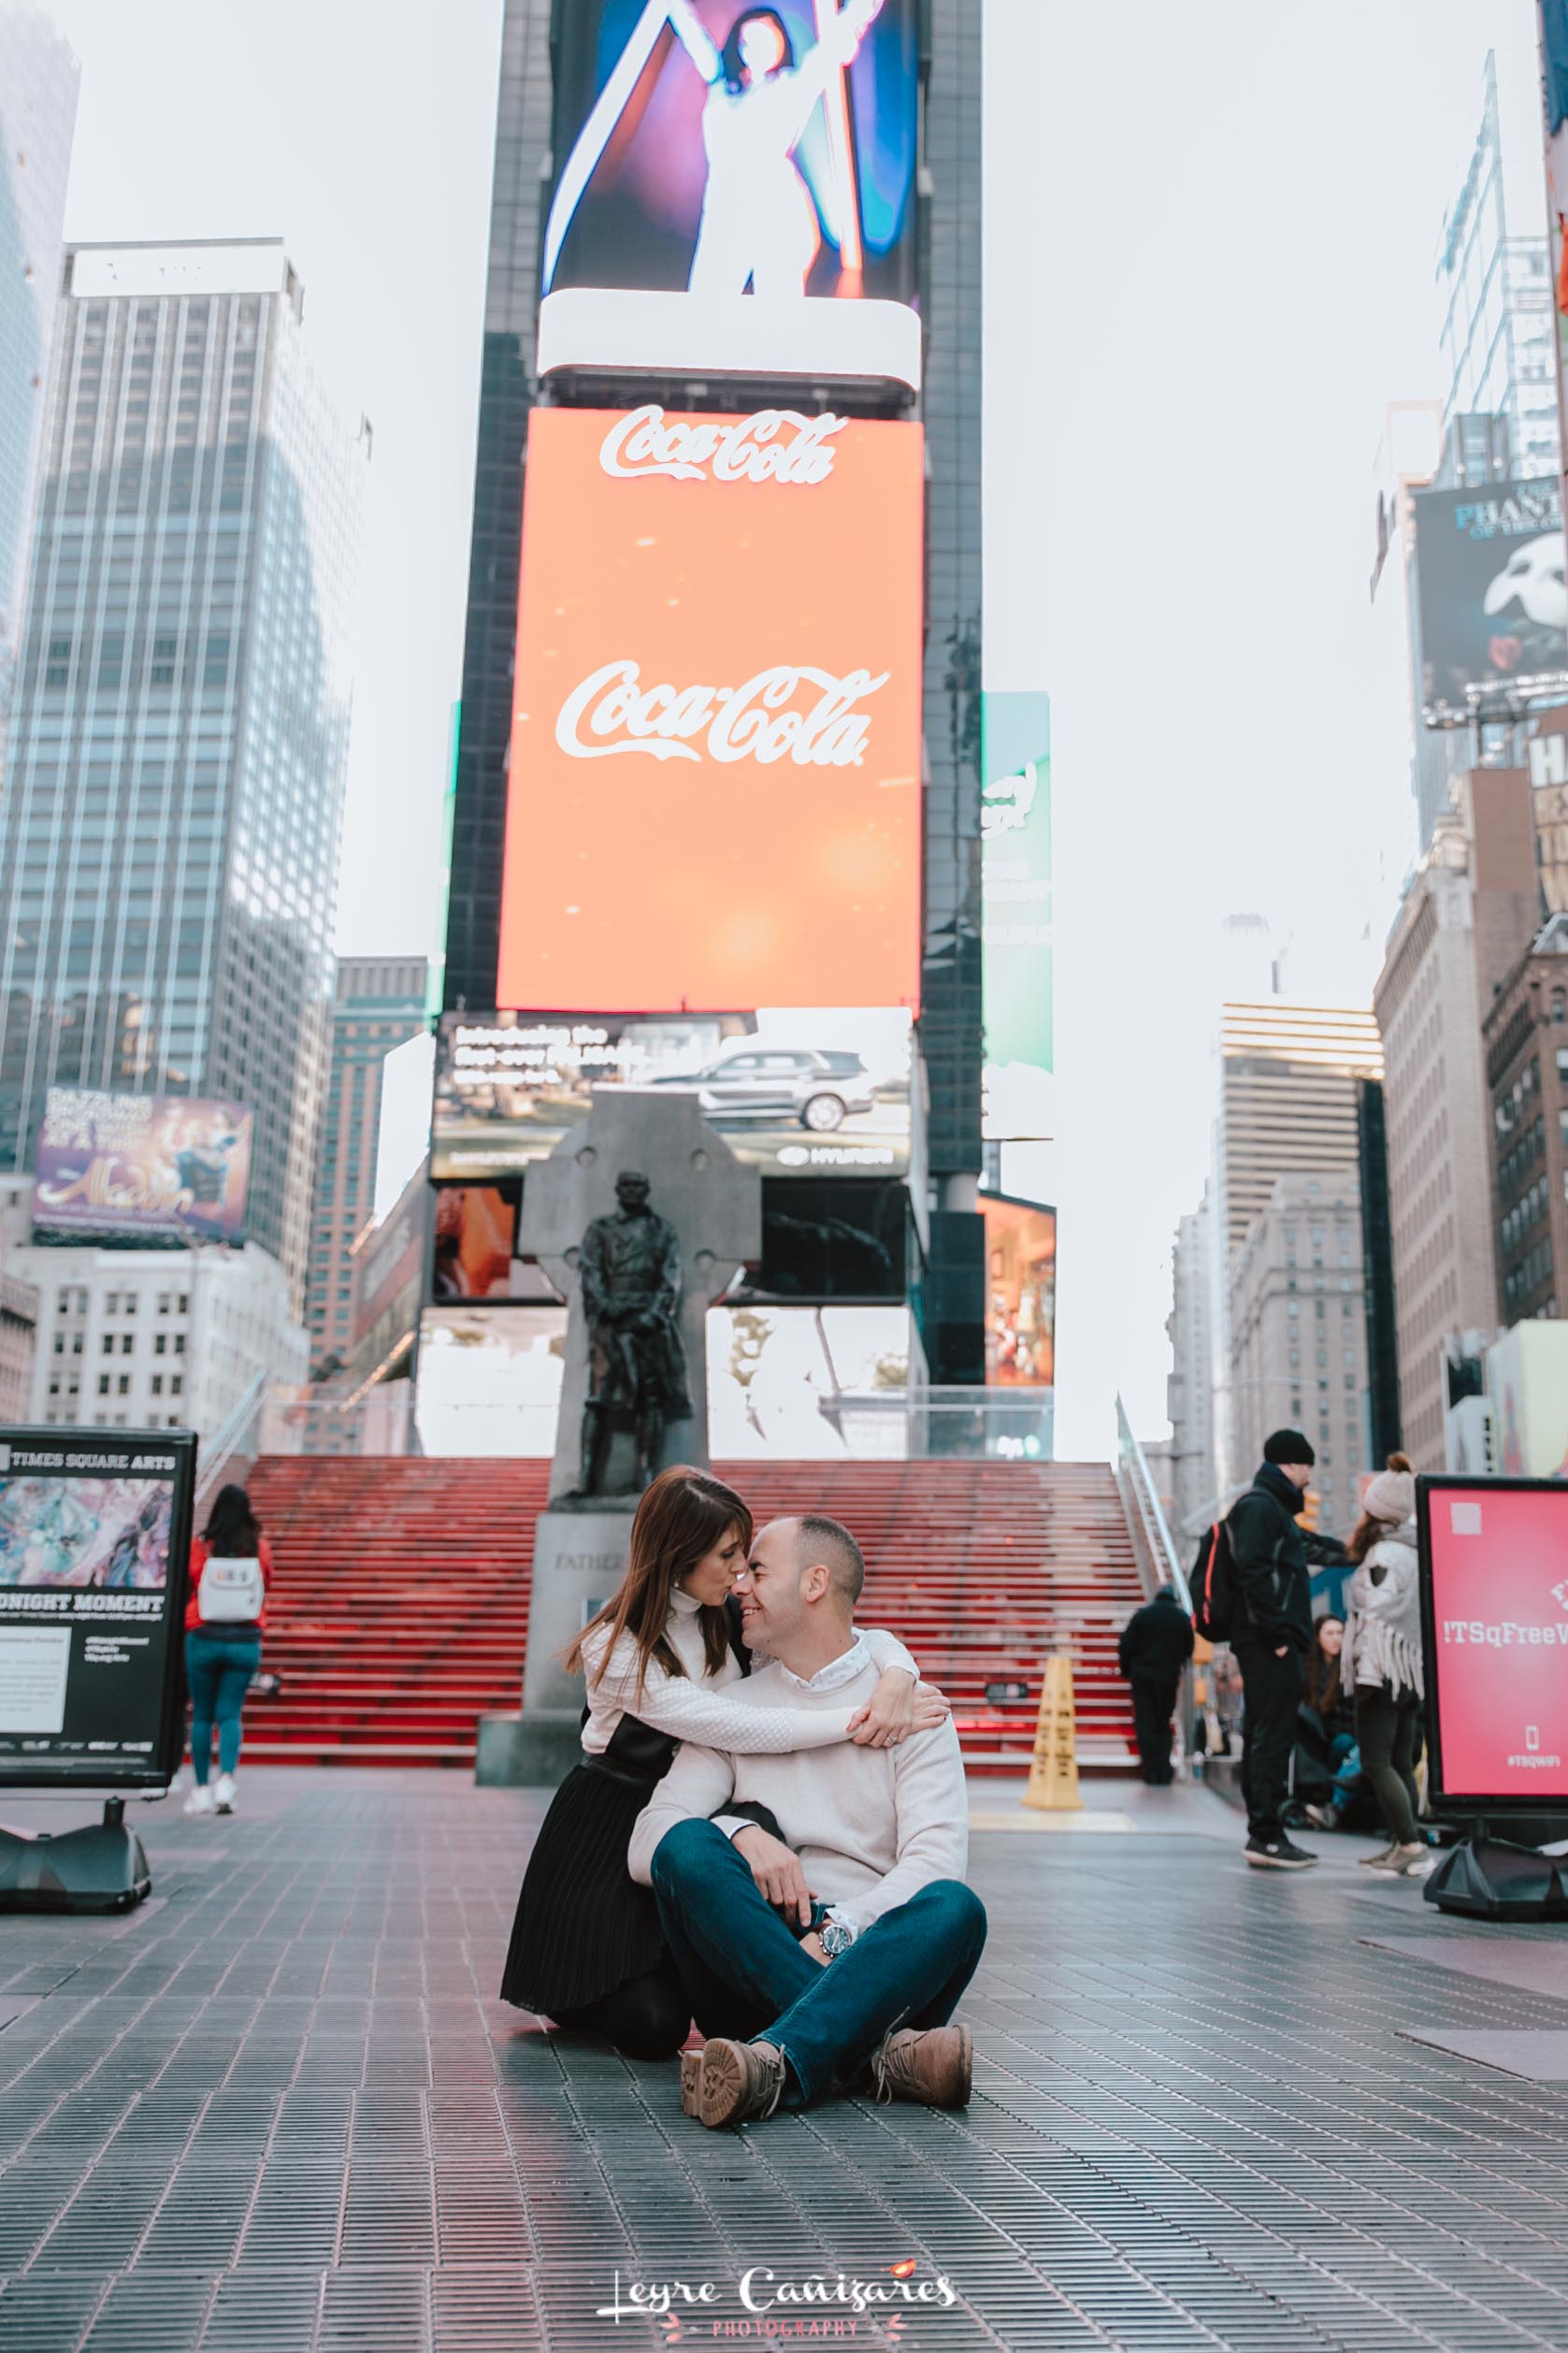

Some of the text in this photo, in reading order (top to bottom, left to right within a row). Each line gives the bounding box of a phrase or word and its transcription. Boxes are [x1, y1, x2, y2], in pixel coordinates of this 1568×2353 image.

[599, 404, 849, 484] Coca-Cola
[555, 659, 891, 767] Coca-Cola
[1530, 732, 1568, 788] H
[12, 1452, 176, 1470] TIMES SQUARE ARTS
[73, 1595, 165, 1611] MOMENT
